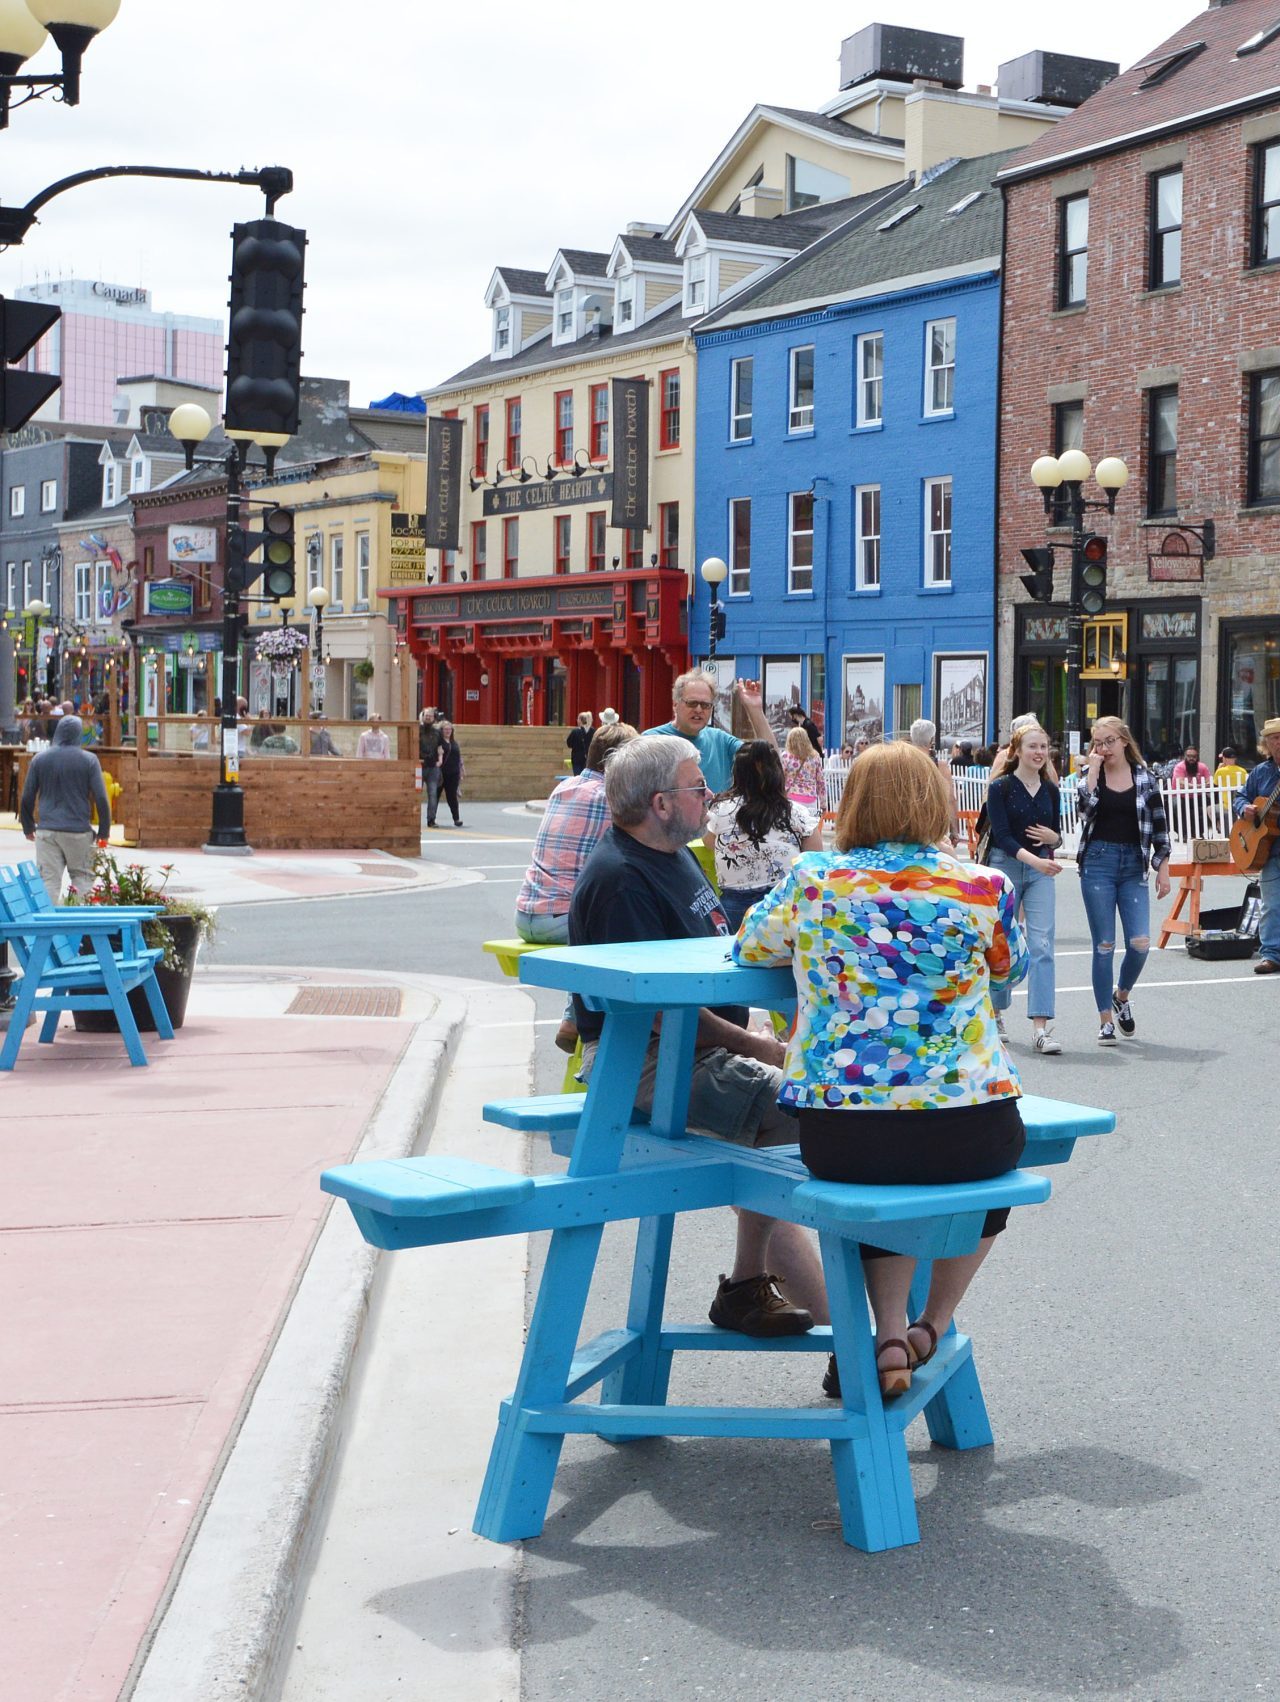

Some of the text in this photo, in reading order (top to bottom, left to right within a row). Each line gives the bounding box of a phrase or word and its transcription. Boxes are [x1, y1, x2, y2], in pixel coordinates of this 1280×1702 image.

[92, 281, 147, 303] Canada
[505, 480, 592, 508] THE CELTIC HEARTH
